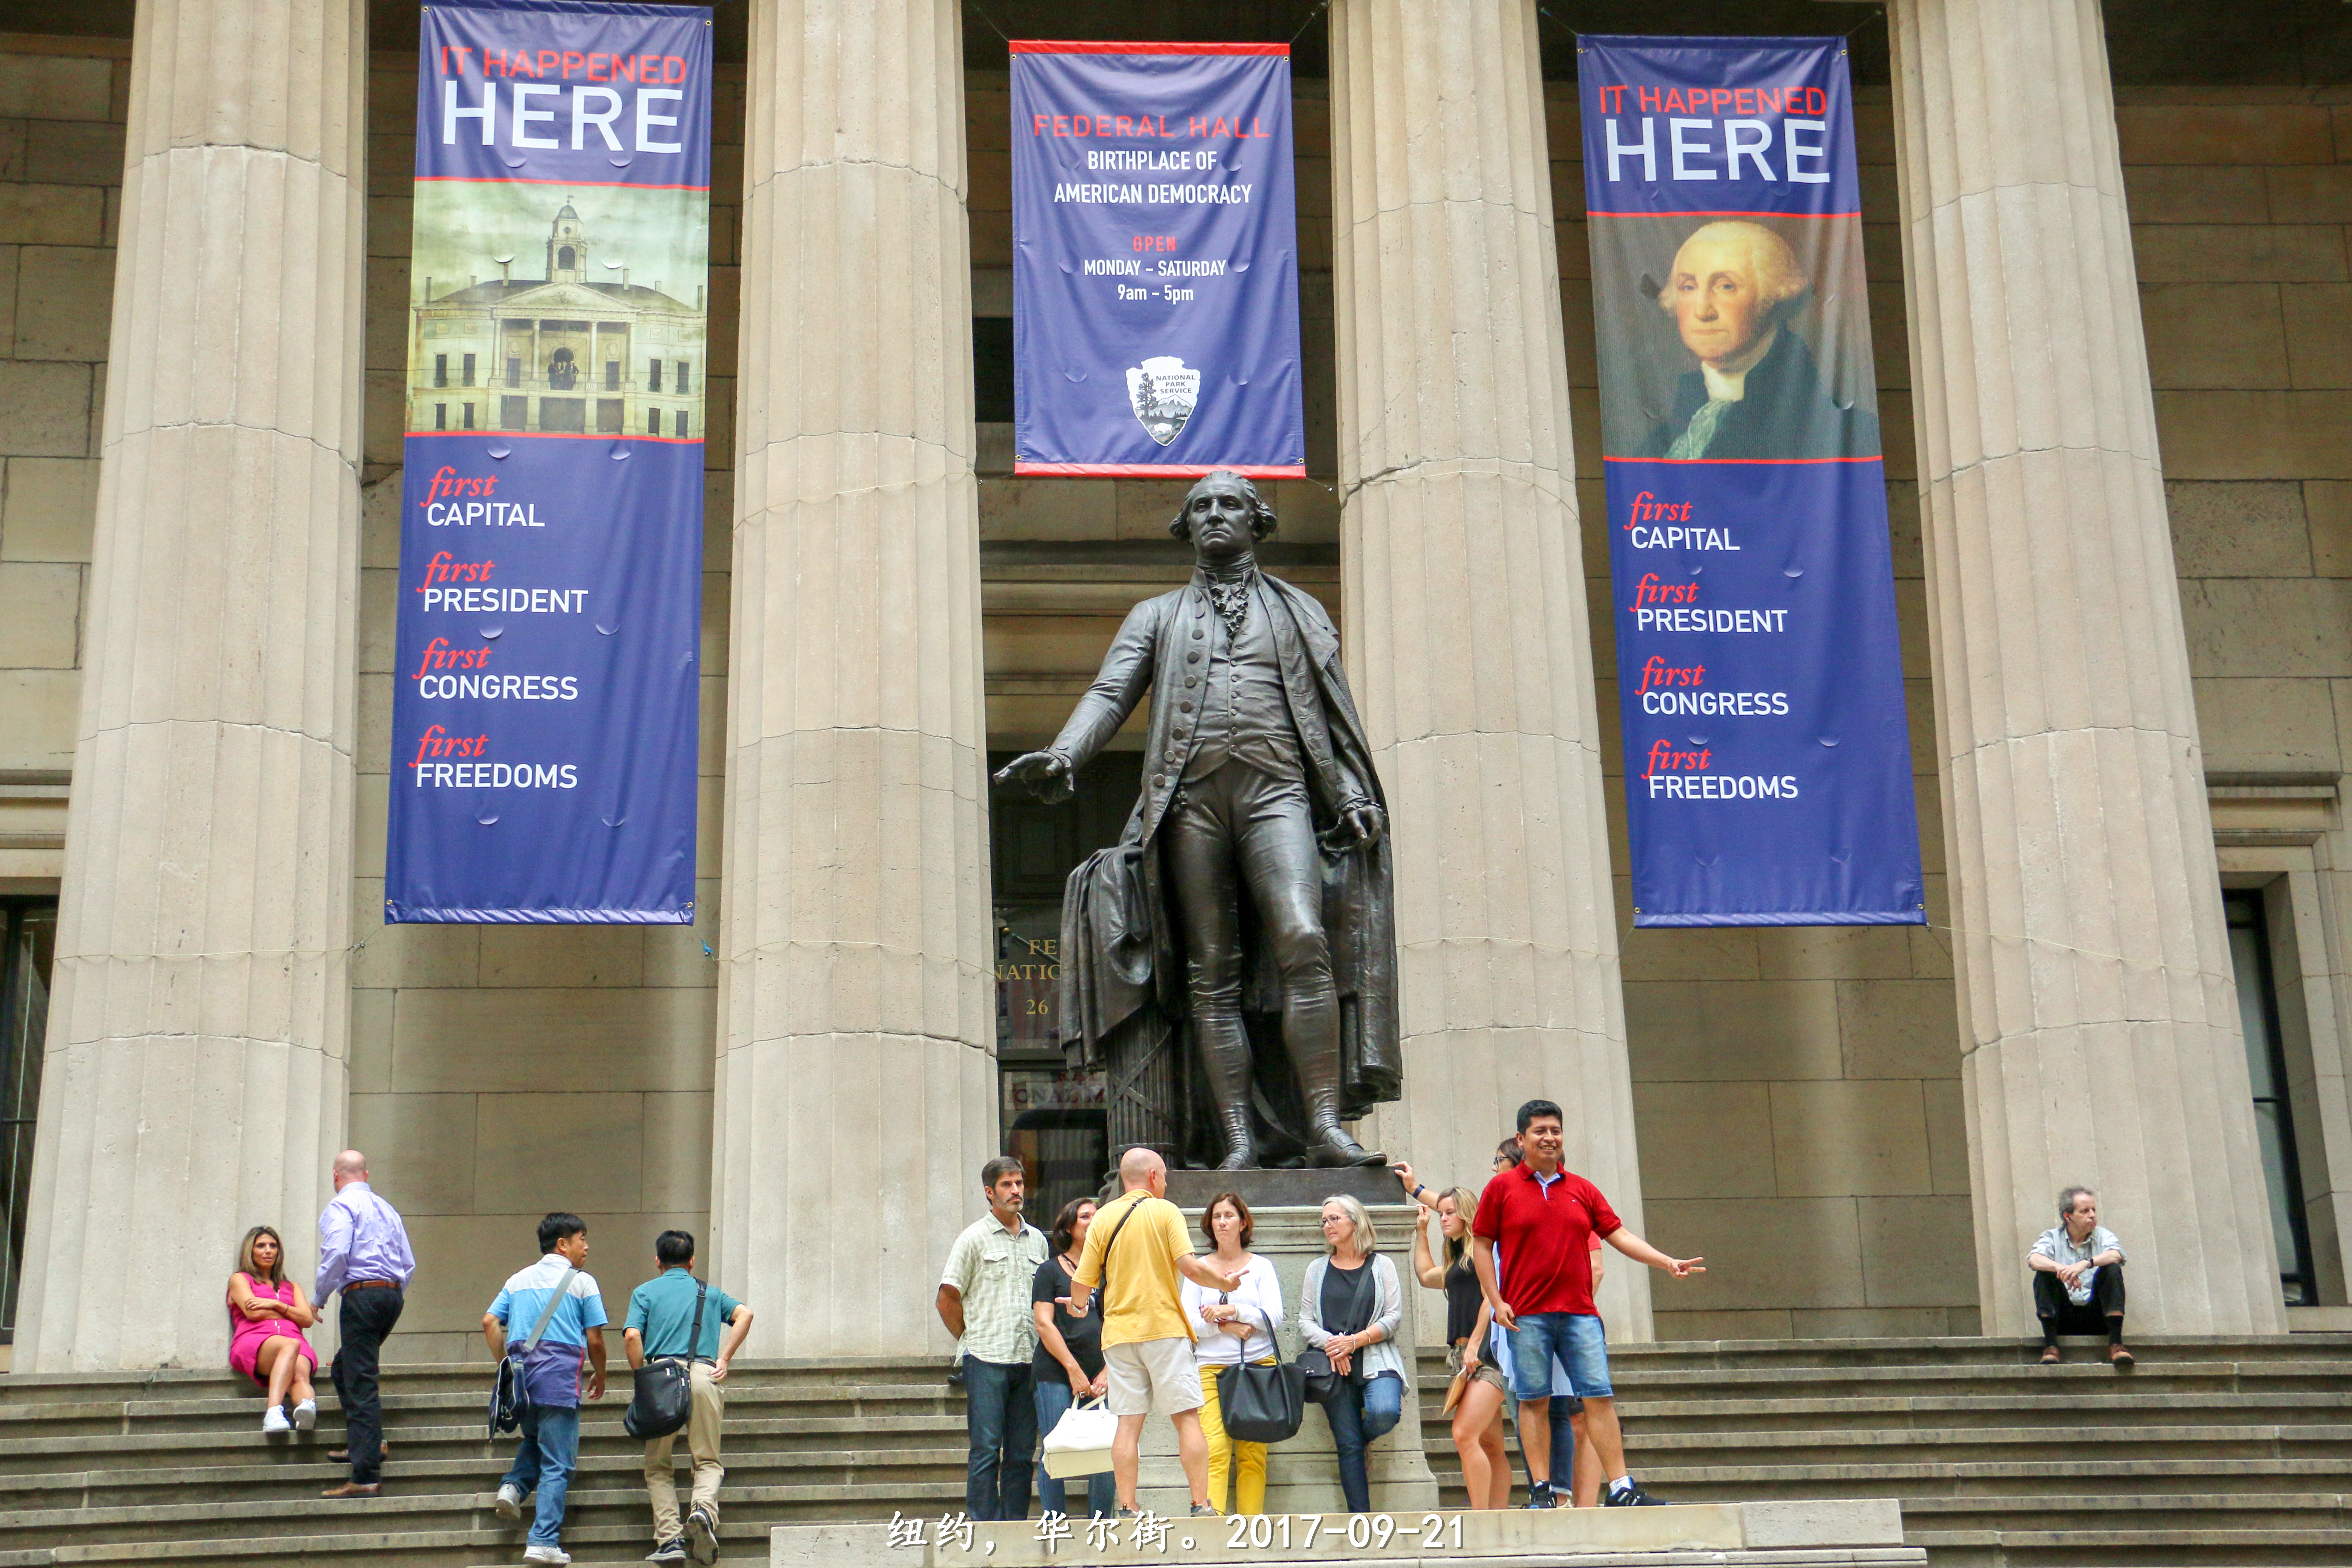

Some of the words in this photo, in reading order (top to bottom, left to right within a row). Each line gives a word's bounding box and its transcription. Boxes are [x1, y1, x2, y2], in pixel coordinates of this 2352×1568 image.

[441, 46, 473, 75] IT
[484, 48, 686, 84] HAPPENED
[1599, 85, 1629, 114] IT
[1638, 86, 1827, 116] HAPPENED
[443, 80, 683, 153] HERE
[1034, 114, 1175, 137] FEDERAL
[1190, 116, 1270, 138] HALL
[1088, 150, 1191, 170] BIRTHPLACE
[1196, 151, 1217, 170] OF
[1605, 117, 1830, 183] HERE
[1054, 183, 1142, 203] AMERICAN
[1148, 184, 1252, 204] DEMOCRACY
[1133, 236, 1176, 252] OPEN
[1084, 259, 1141, 276] MONDAY
[1158, 260, 1226, 277] SATURDAY
[1118, 284, 1147, 300] 9am
[1164, 285, 1194, 305] 5pm
[419, 466, 499, 508] first
[427, 502, 545, 527] CAPITAL
[1623, 491, 1694, 530] first
[1632, 526, 1740, 550] CAPITAL
[416, 551, 496, 593] first
[424, 588, 588, 613] PRESIDENT
[1629, 573, 1700, 612] first
[1637, 609, 1788, 632] PRESIDENT
[412, 637, 492, 680] first
[420, 675, 578, 700] CONGRESS
[1635, 655, 1706, 695] first
[1643, 692, 1788, 715] CONGRESS
[408, 724, 490, 768] first
[1641, 739, 1712, 780] first
[416, 763, 577, 789] FREEDOMS
[1649, 775, 1798, 799] FREEDOMS
[1029, 940, 1060, 955] FE
[1026, 999, 1048, 1015] 26
